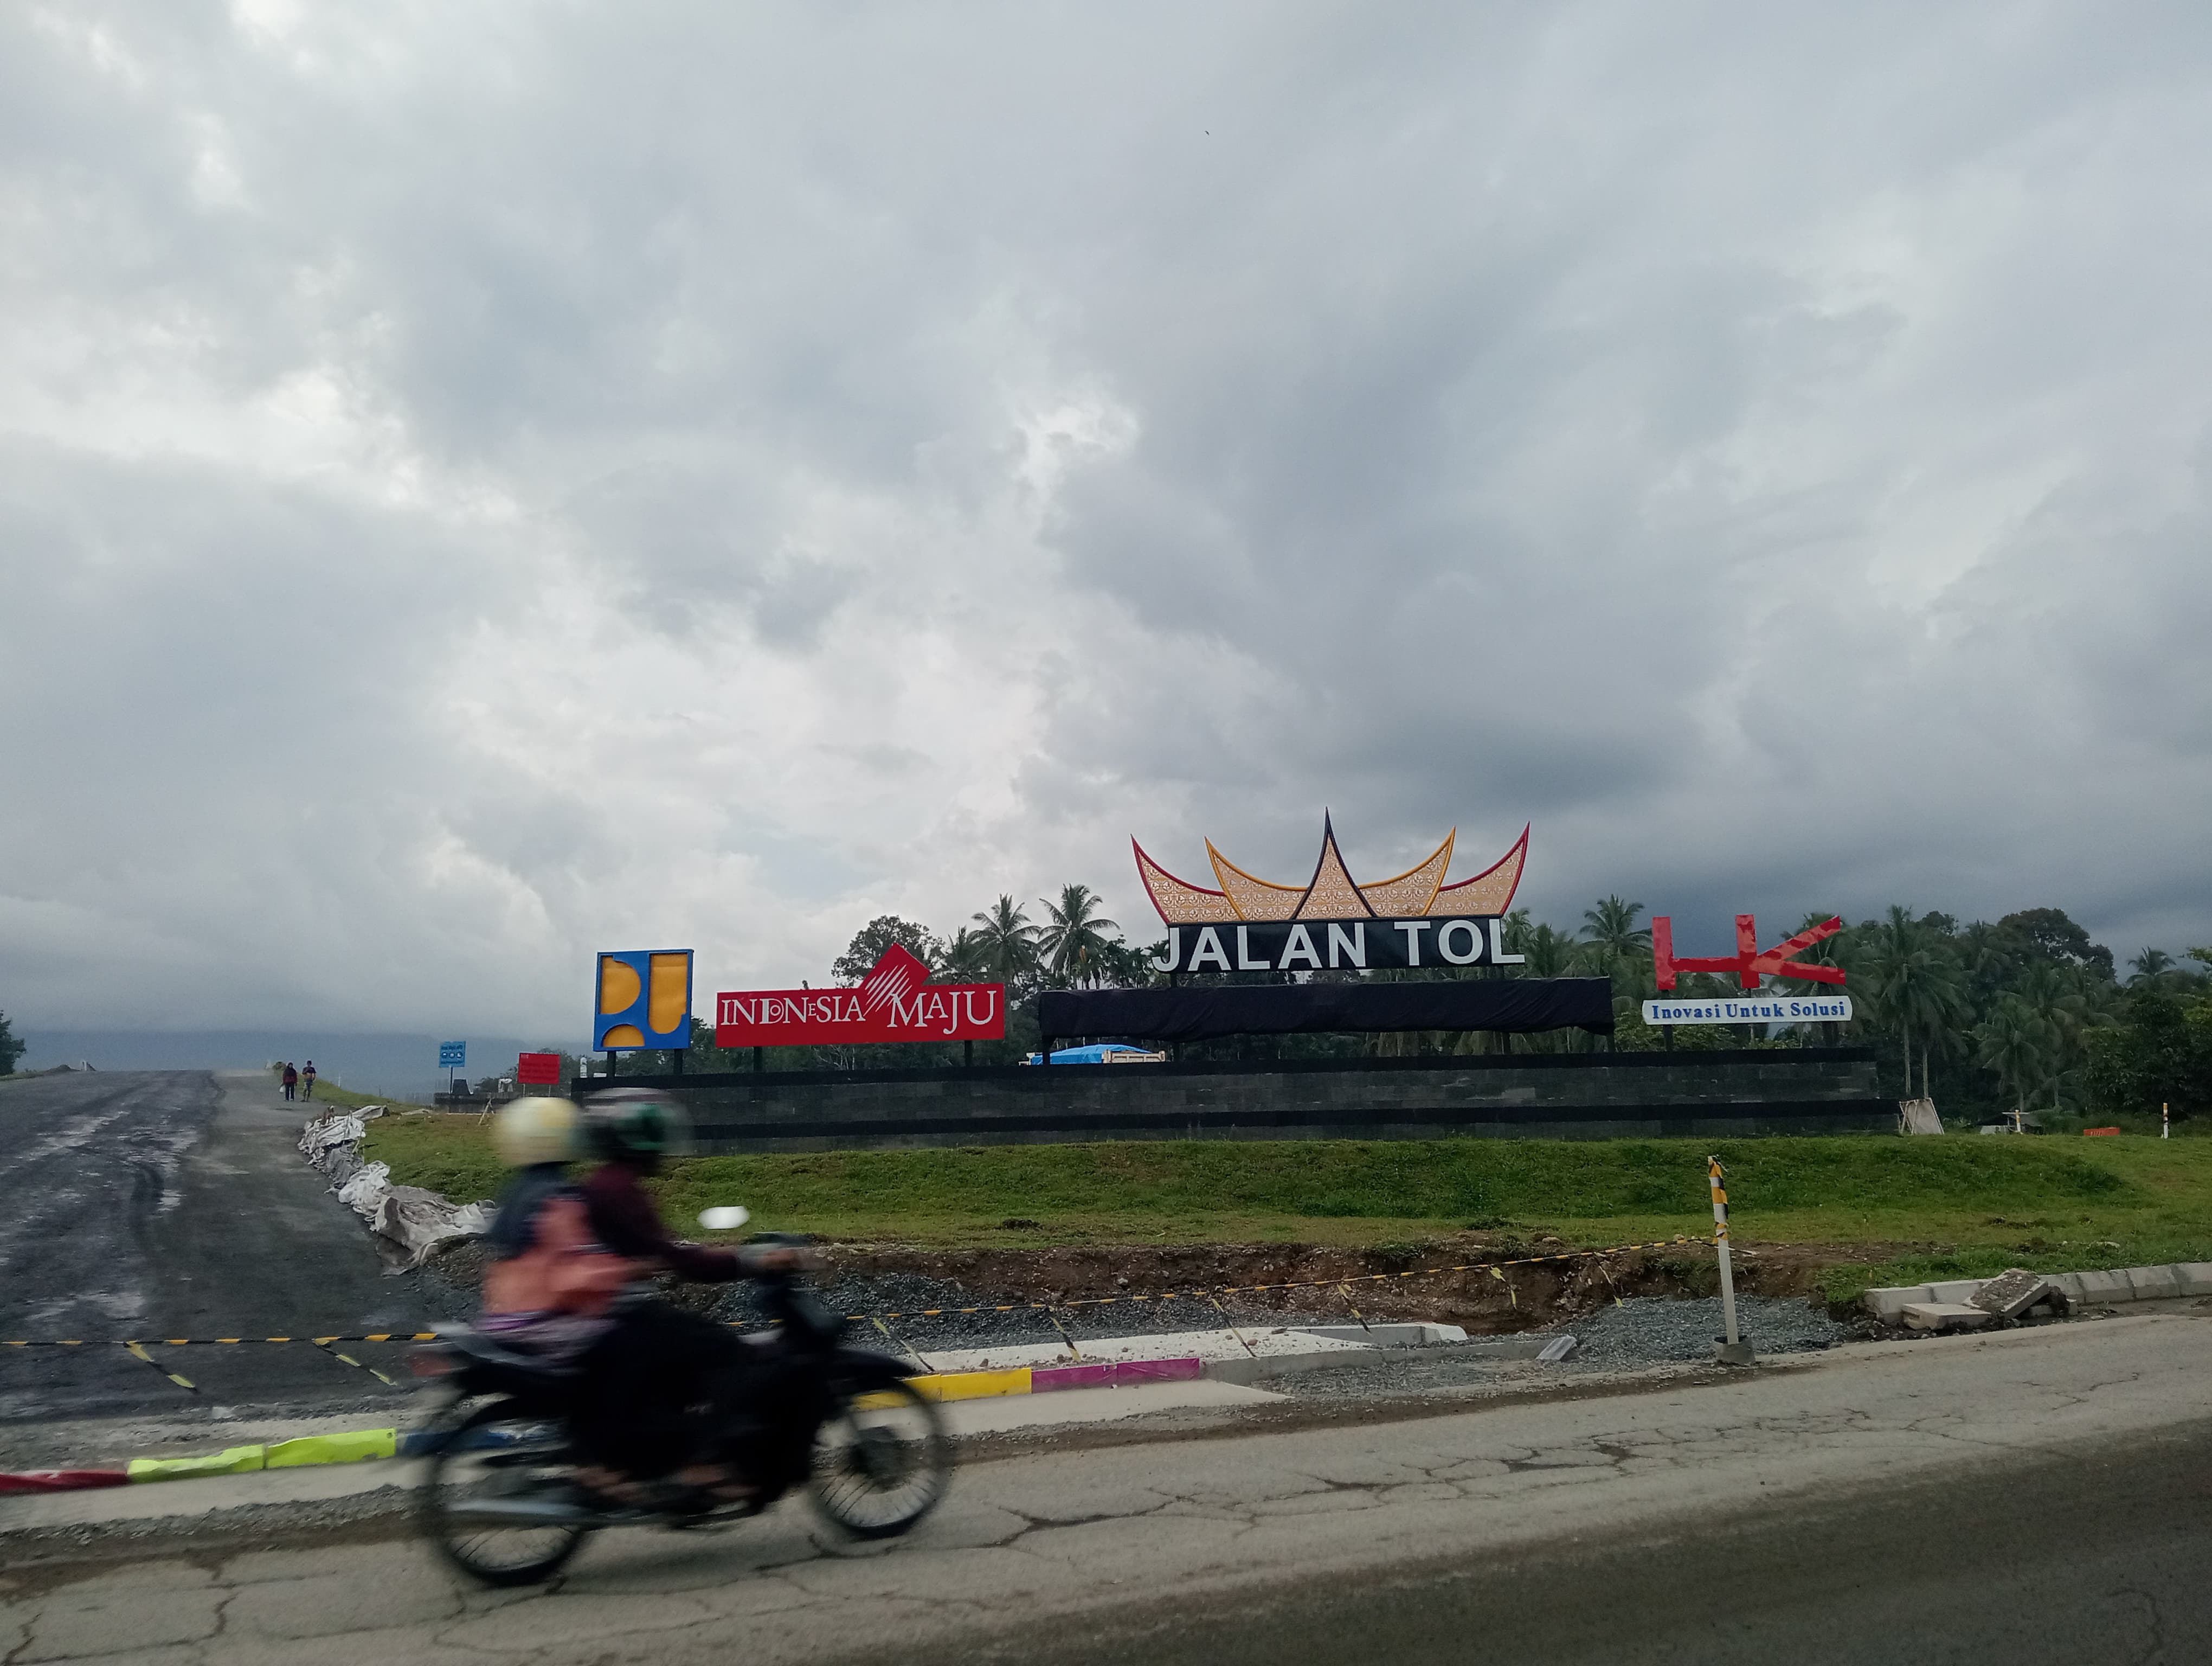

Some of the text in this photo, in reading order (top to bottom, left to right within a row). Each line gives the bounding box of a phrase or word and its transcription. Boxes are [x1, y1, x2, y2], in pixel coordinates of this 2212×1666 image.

[1152, 919, 1525, 971] JALAN TOL
[721, 990, 998, 1035] INDONESIA MAJU
[1652, 1001, 1845, 1019] Inovasi Untuk Solusi
